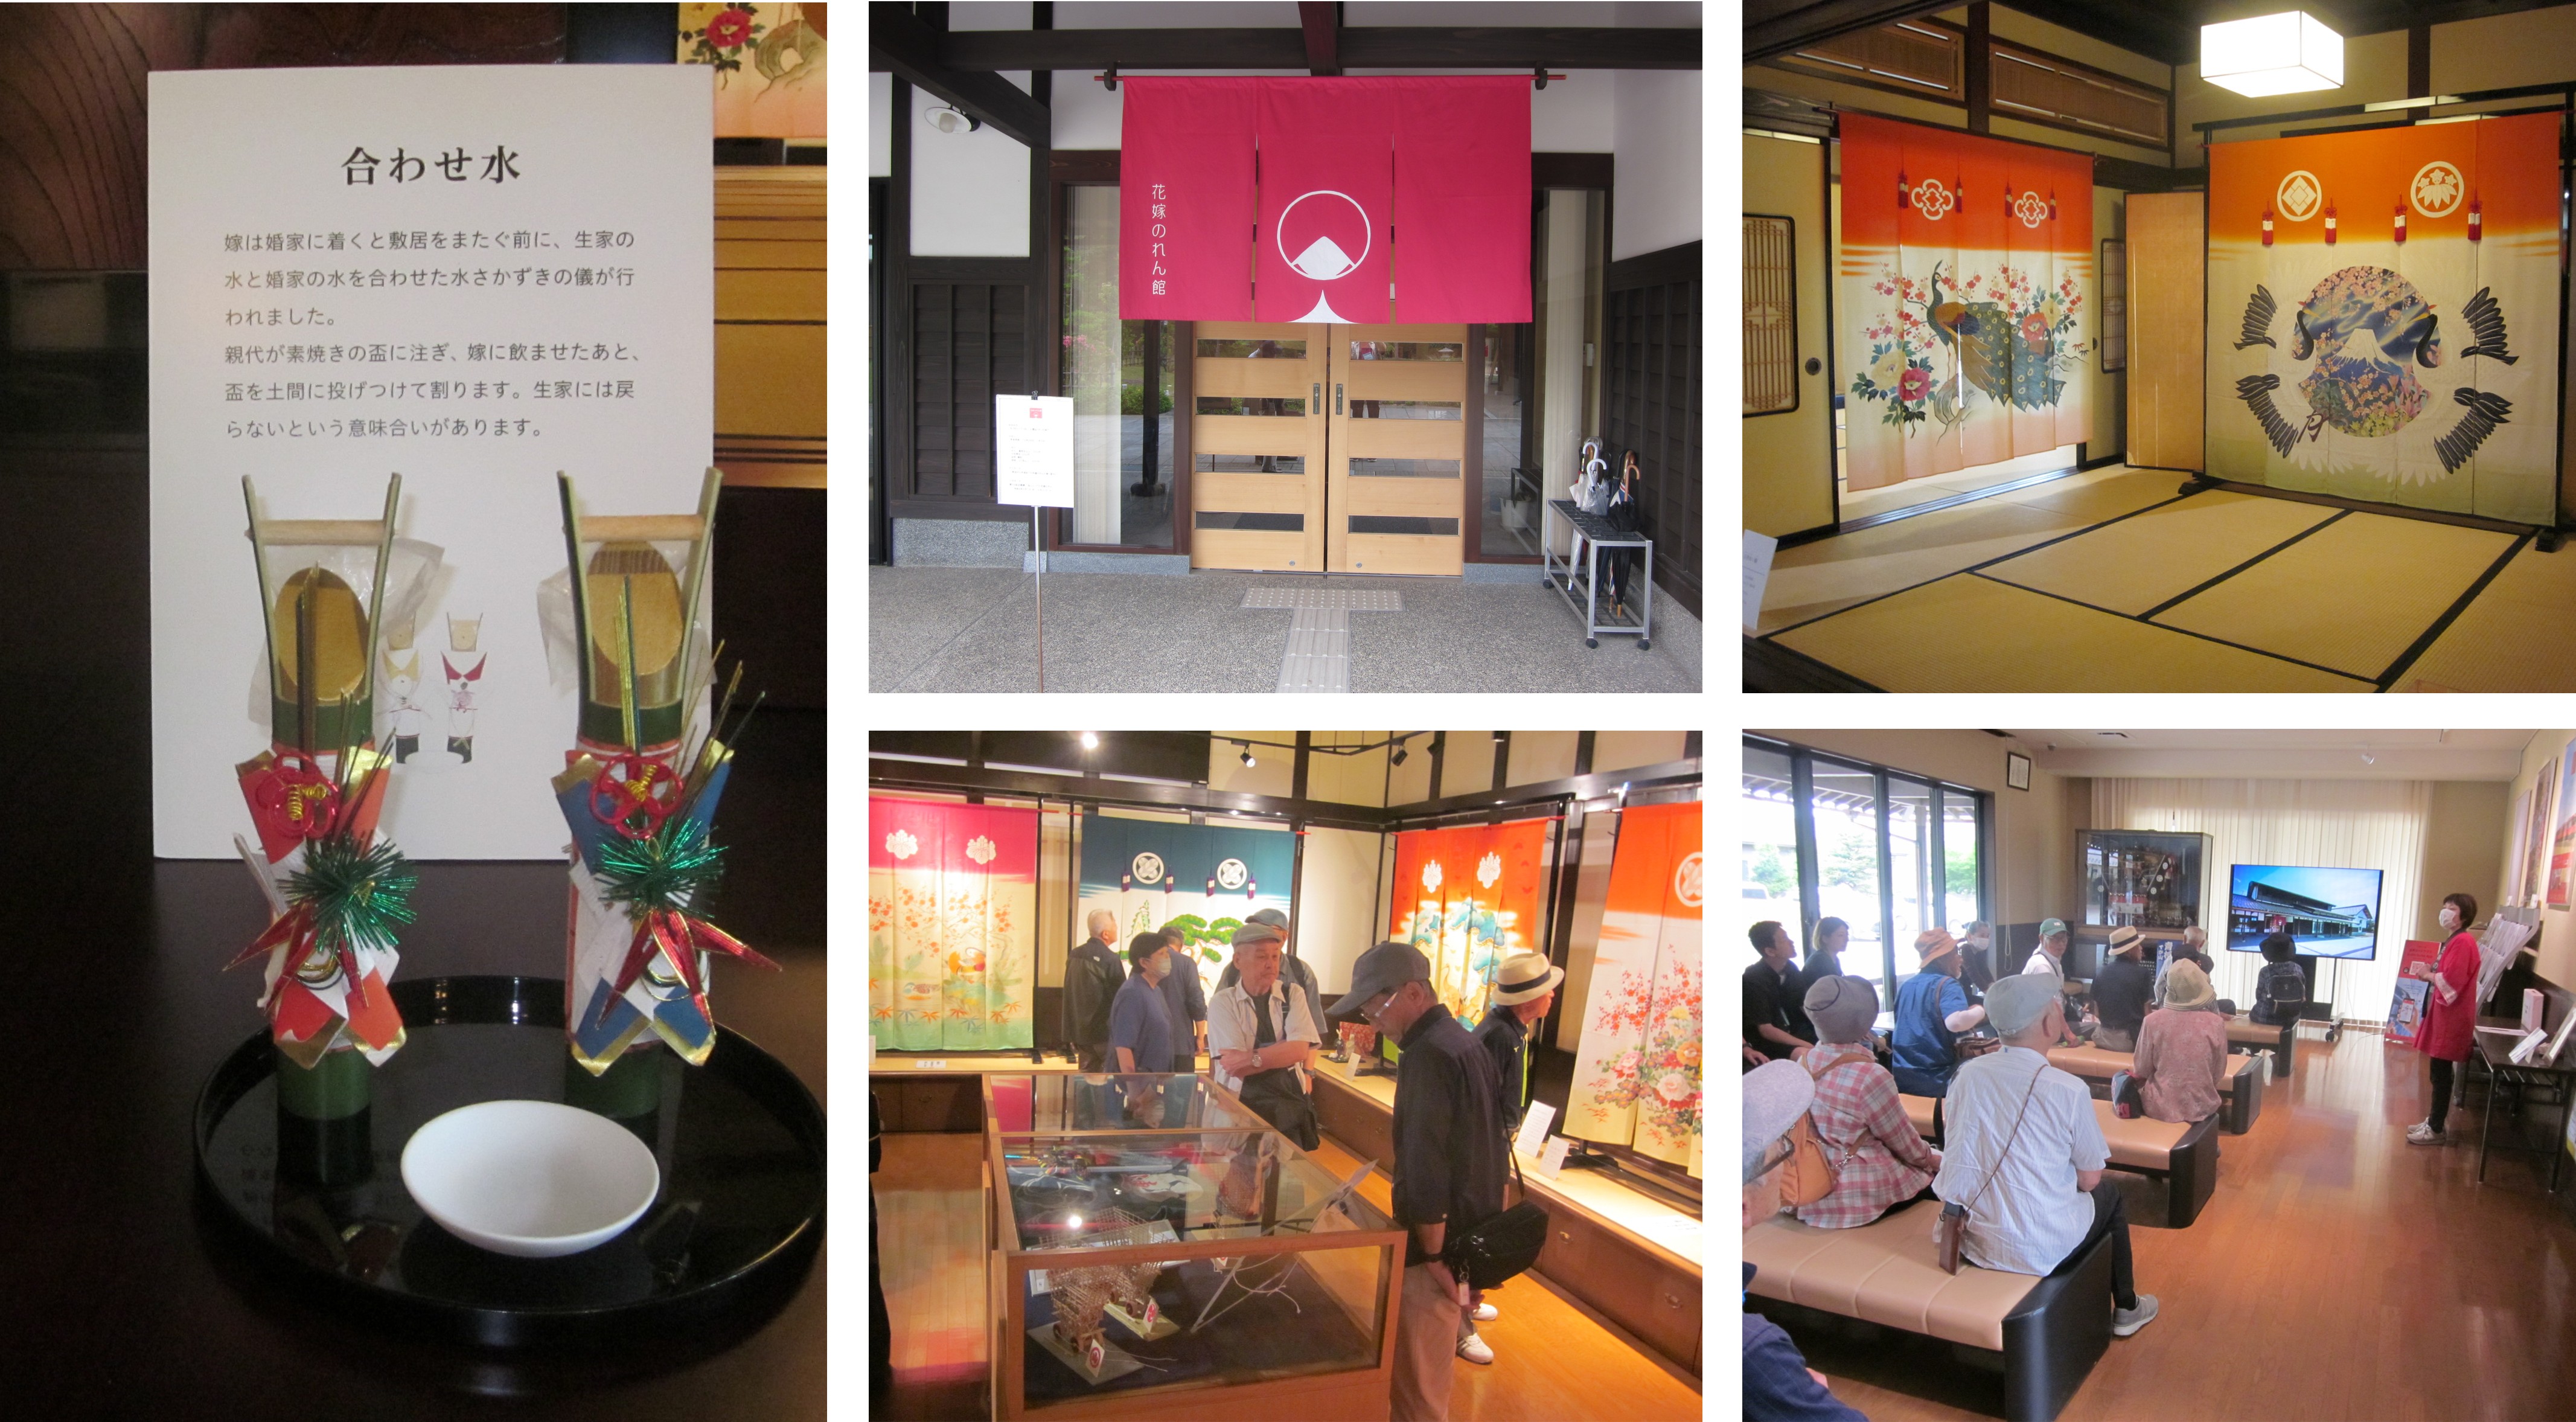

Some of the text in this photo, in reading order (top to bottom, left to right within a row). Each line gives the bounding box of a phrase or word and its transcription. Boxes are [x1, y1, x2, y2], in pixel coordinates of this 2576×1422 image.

[341, 145, 522, 187] 合わせ水
[224, 230, 635, 253] 嫁は婚家に着くと敷居をまたぐ前に、生家の
[1151, 183, 1167, 296] 花嫁のれん館
[224, 267, 635, 290] 水と婚家の水を合わせた水さかずきの儀が行
[225, 307, 336, 327] われました。
[225, 342, 640, 365] 親代が素焼きの盃に注ぎ、嫁に飲ませたあと、
[225, 380, 635, 402] 盃を土間に投げつけて割ります。生家には戻
[227, 417, 542, 439] らないという意味合いがあります。
